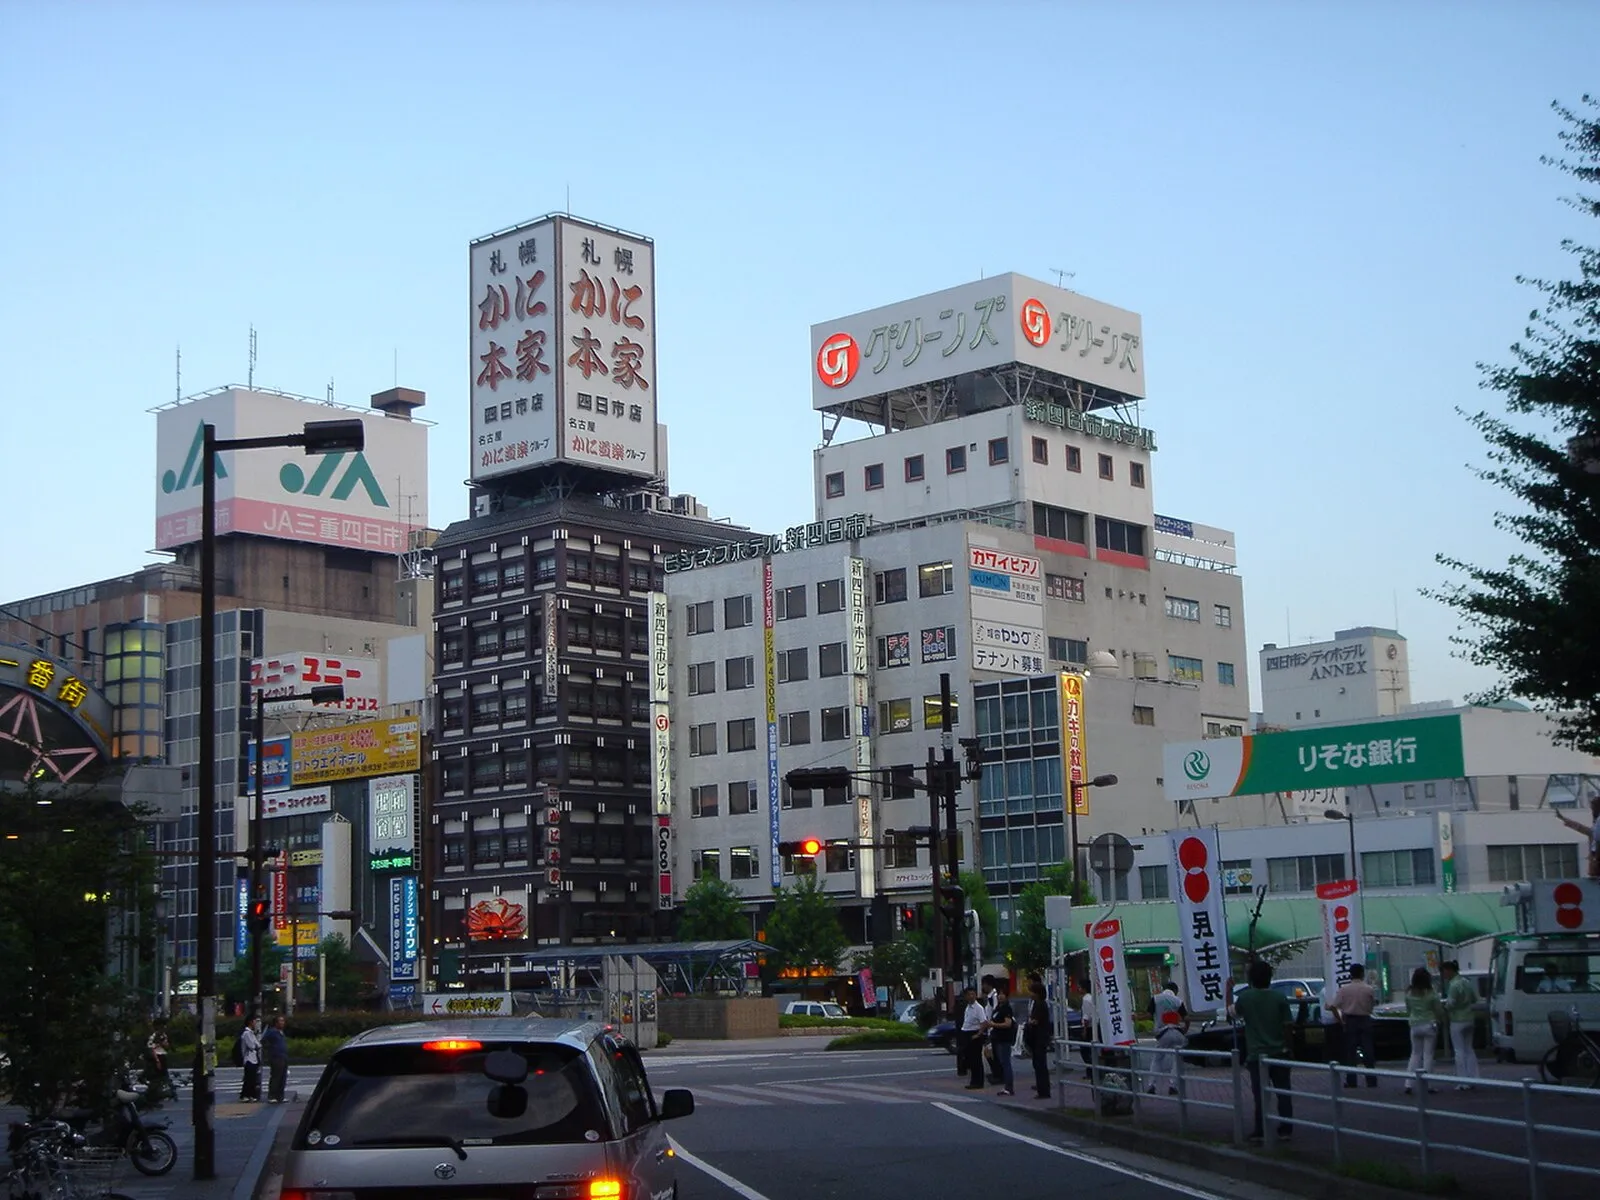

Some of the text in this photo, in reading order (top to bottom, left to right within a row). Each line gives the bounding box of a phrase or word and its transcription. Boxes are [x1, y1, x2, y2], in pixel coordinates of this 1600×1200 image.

[490, 237, 537, 275] 札幌
[581, 237, 634, 275] 札幌
[478, 269, 547, 331] かに
[569, 268, 645, 331] かに
[864, 295, 1006, 375] グリーンズ
[1054, 312, 1140, 373] グリーンズ
[477, 329, 551, 392] 本家
[568, 327, 649, 391] 本家
[484, 393, 544, 424] 四日市店
[569, 417, 596, 433] 名古屋
[577, 392, 643, 424] 四日市店
[1024, 399, 1158, 452] 新四日市ホテル
[478, 430, 503, 446] 名古屋
[264, 508, 403, 548] JA三重四日市
[973, 550, 1037, 575] カワイピアノ
[974, 574, 1007, 588] KUMON
[851, 560, 866, 671] 新四日市ホテル
[654, 602, 667, 692] 新四日市ビル
[976, 650, 1043, 673] テナント募集
[1266, 643, 1366, 671] 四日市シティホテル
[302, 657, 363, 684] ユニー
[1310, 660, 1368, 681] ANNEX
[1298, 737, 1418, 773] りそな銀行
[406, 917, 416, 949] エイワ
